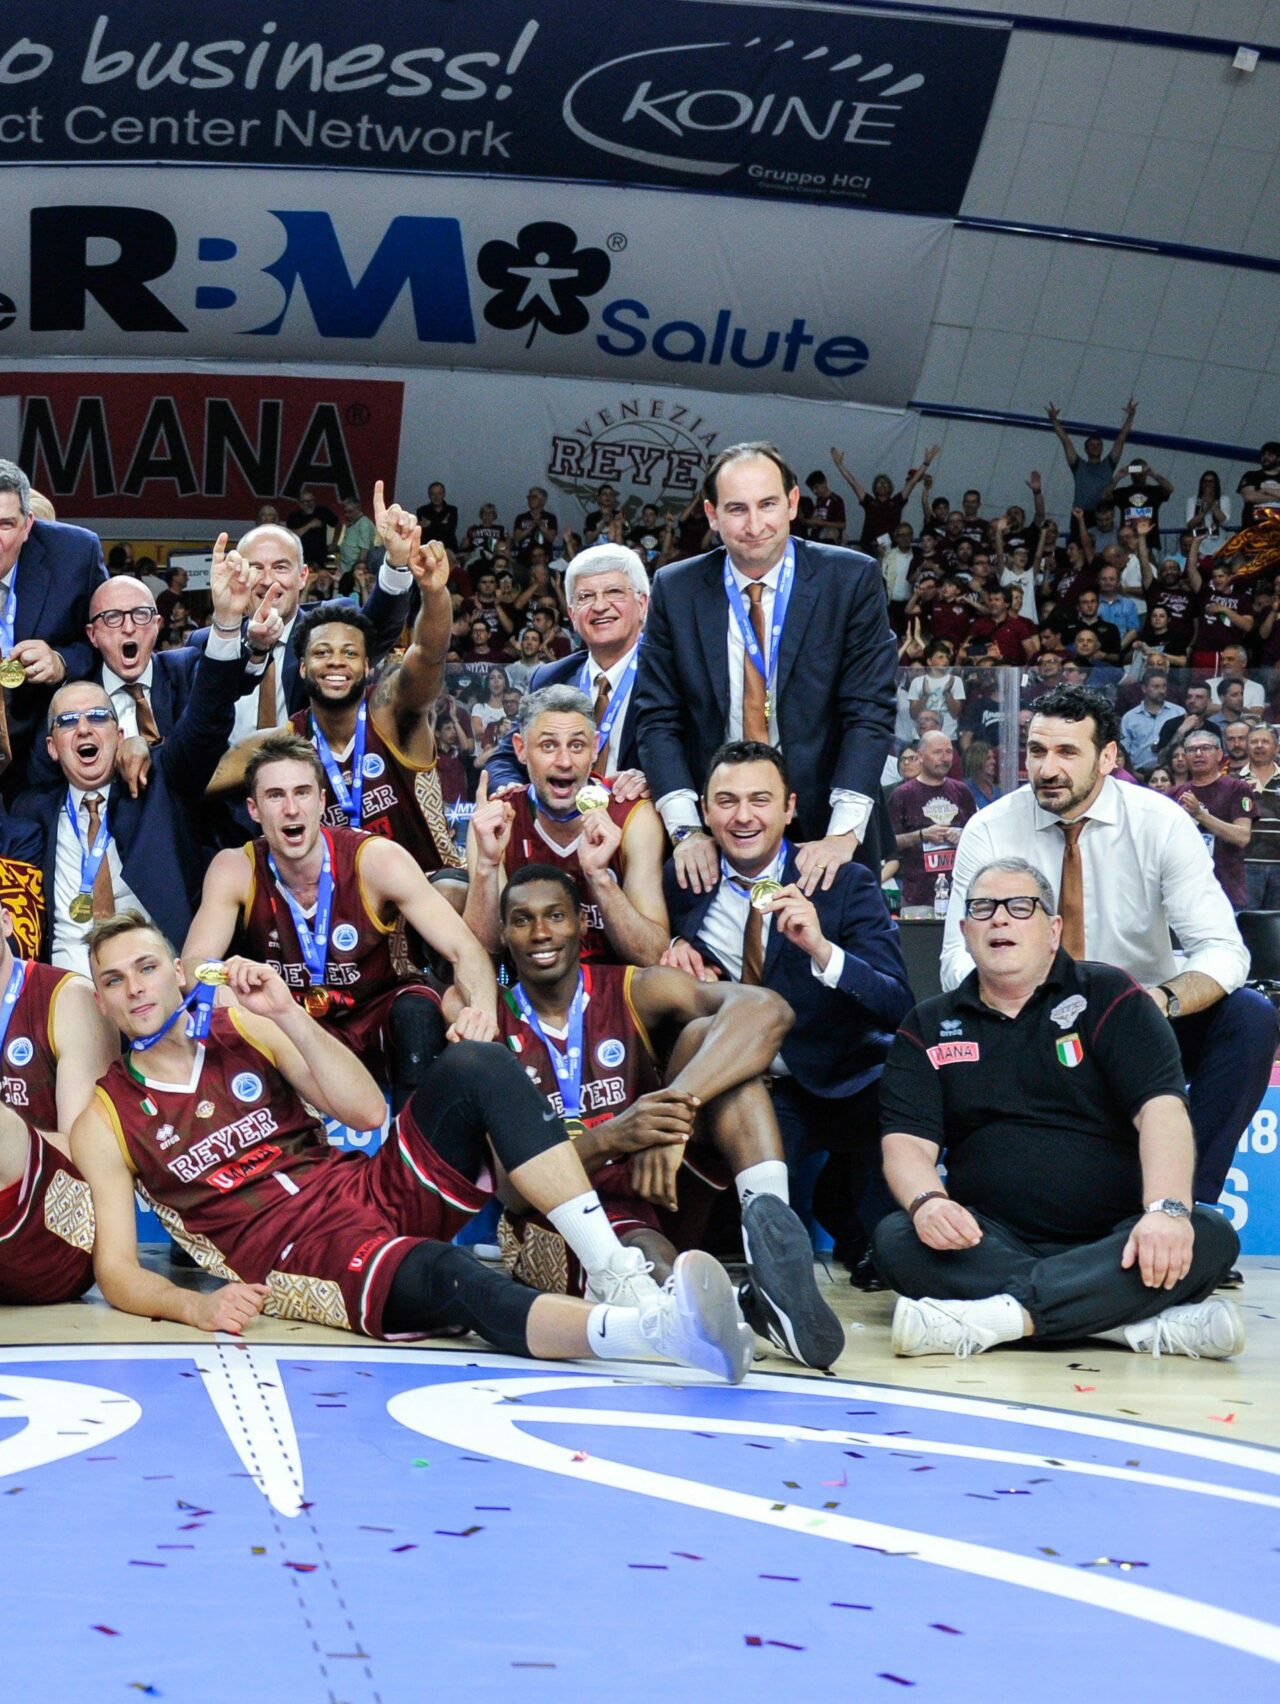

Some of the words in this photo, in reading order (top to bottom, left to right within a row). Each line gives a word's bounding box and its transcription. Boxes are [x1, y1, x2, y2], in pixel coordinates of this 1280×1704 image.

[81, 14, 541, 102] business!
[64, 106, 262, 149] Center
[275, 110, 512, 159] Network
[747, 164, 826, 185] Gruppo
[832, 173, 872, 190] HCI
[30, 205, 478, 344] RBM
[596, 298, 870, 379] Salute
[575, 399, 720, 449] VENEZIA
[547, 435, 715, 492] REYE
[167, 1107, 280, 1184] REYER
